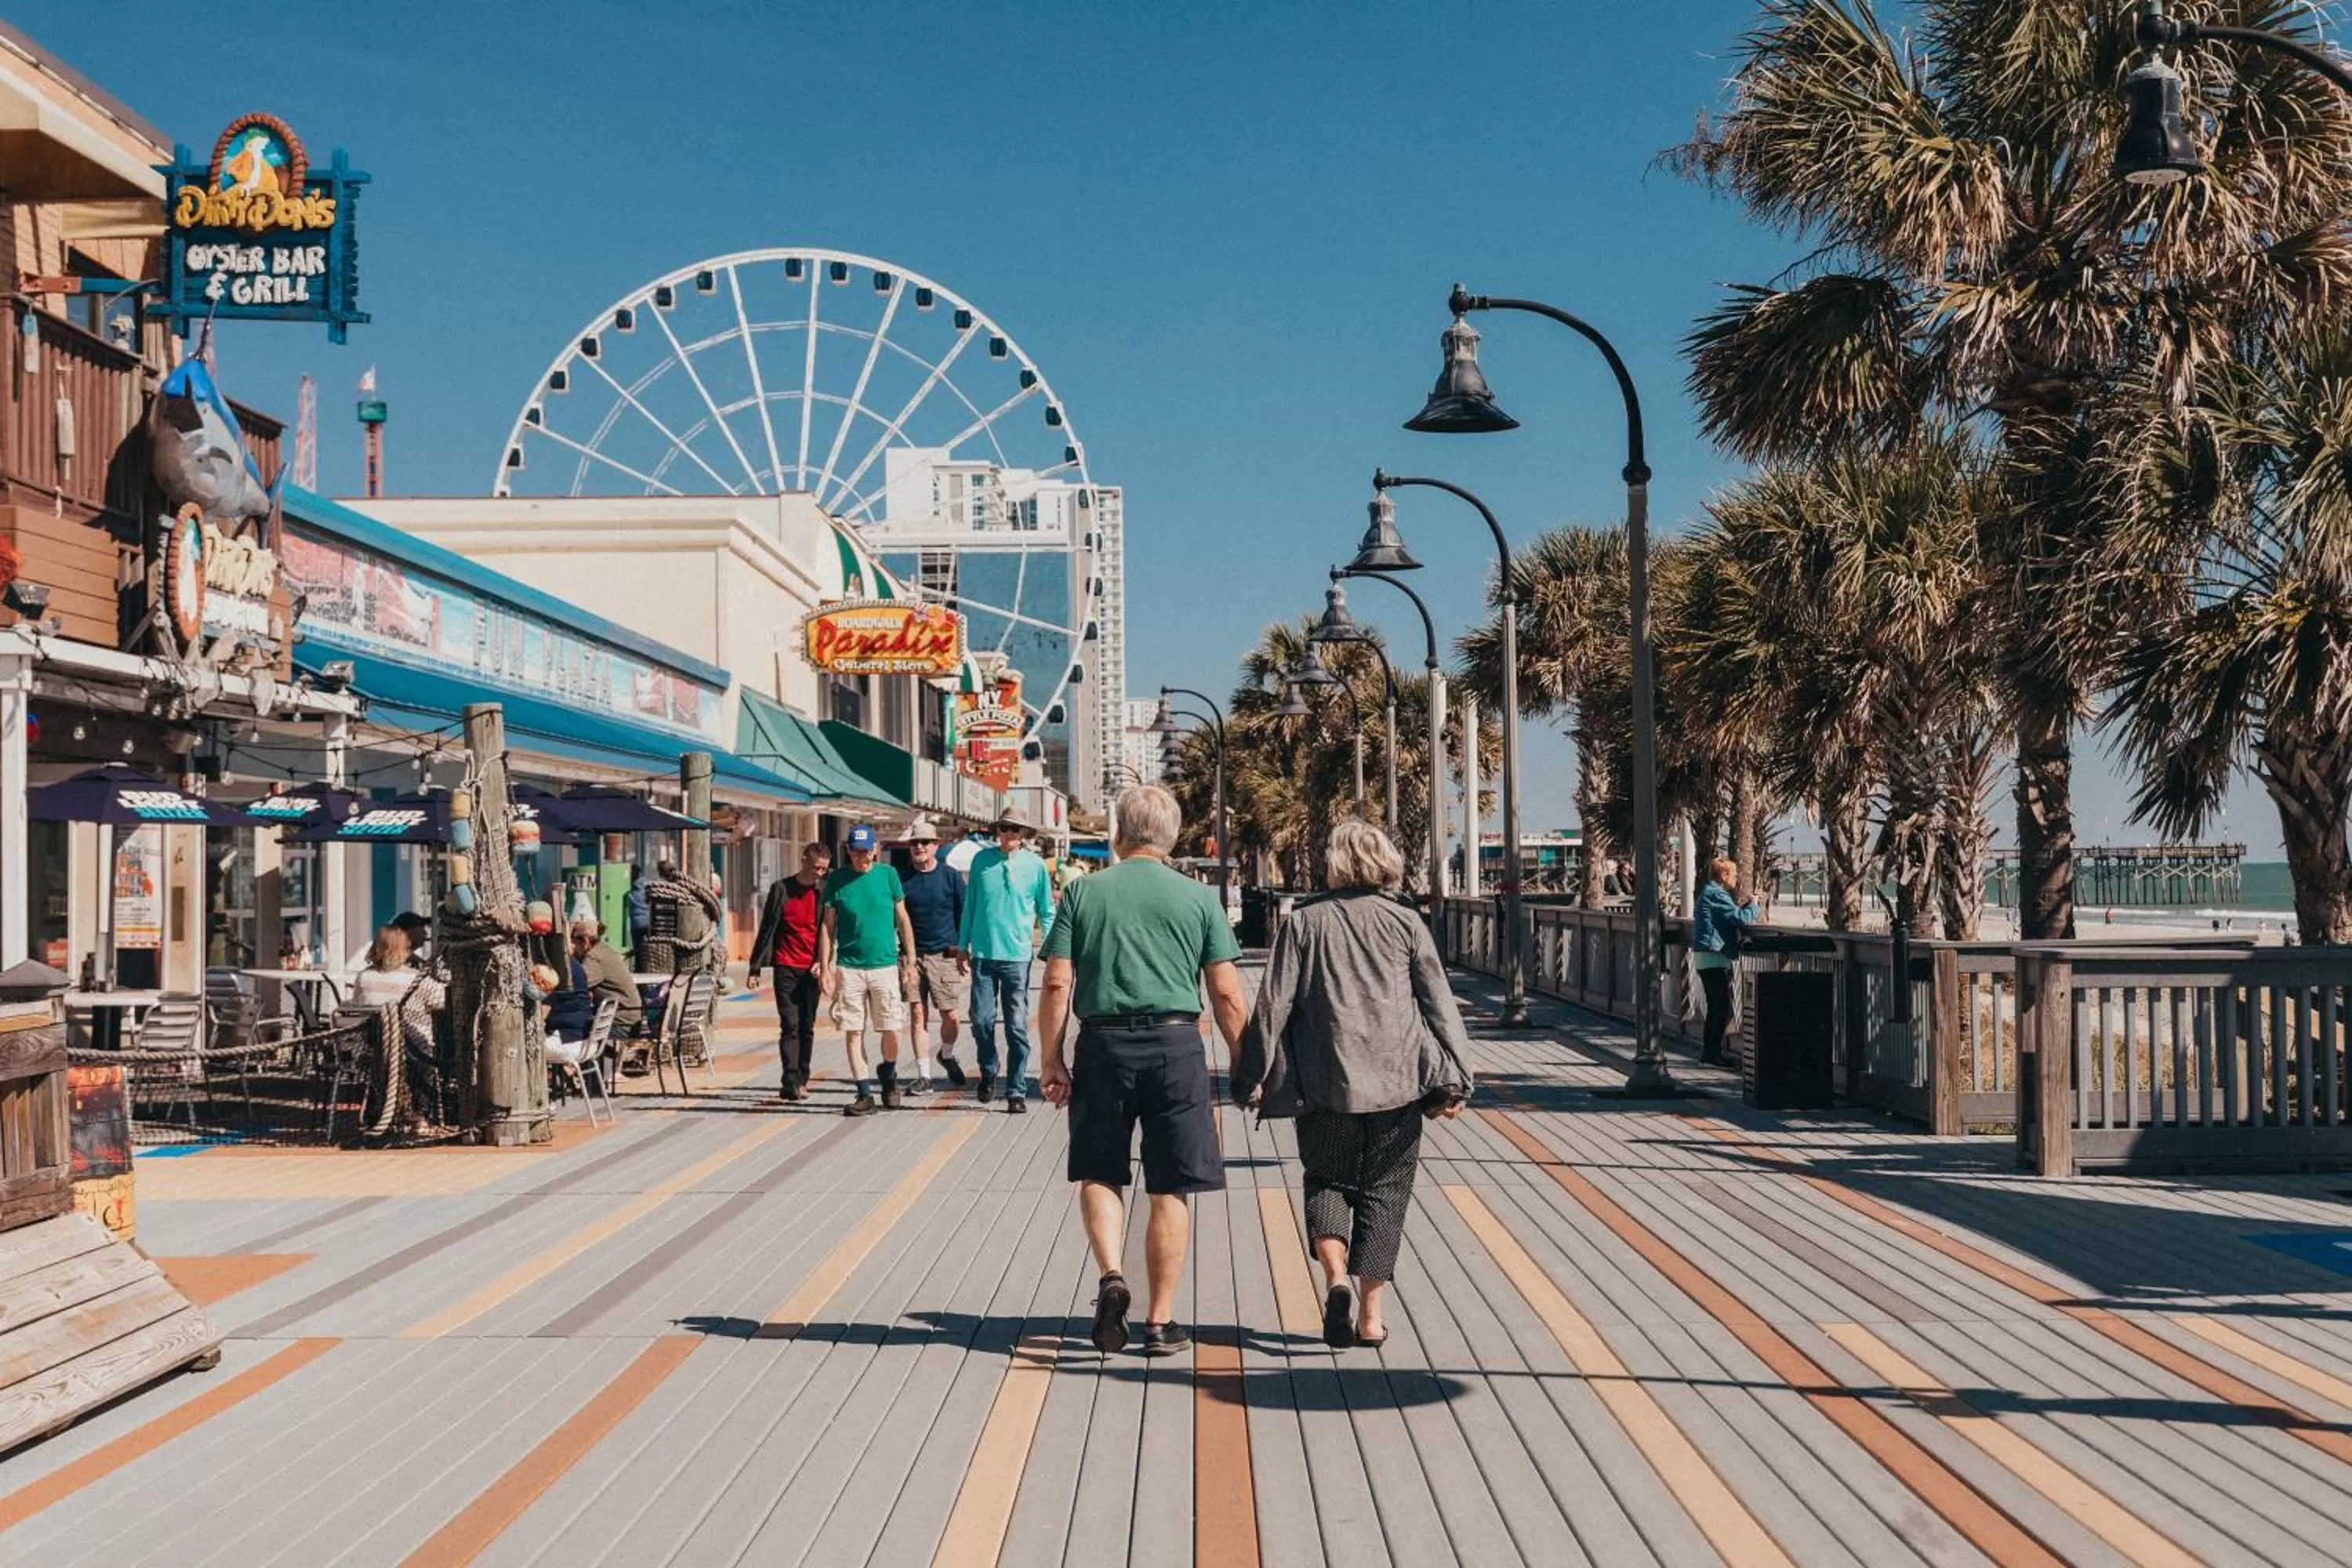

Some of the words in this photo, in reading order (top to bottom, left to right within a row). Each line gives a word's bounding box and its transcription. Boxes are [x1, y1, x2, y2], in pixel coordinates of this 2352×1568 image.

[186, 244, 266, 272] OYSTER
[272, 246, 326, 275] BAR
[231, 274, 310, 305] GRILL
